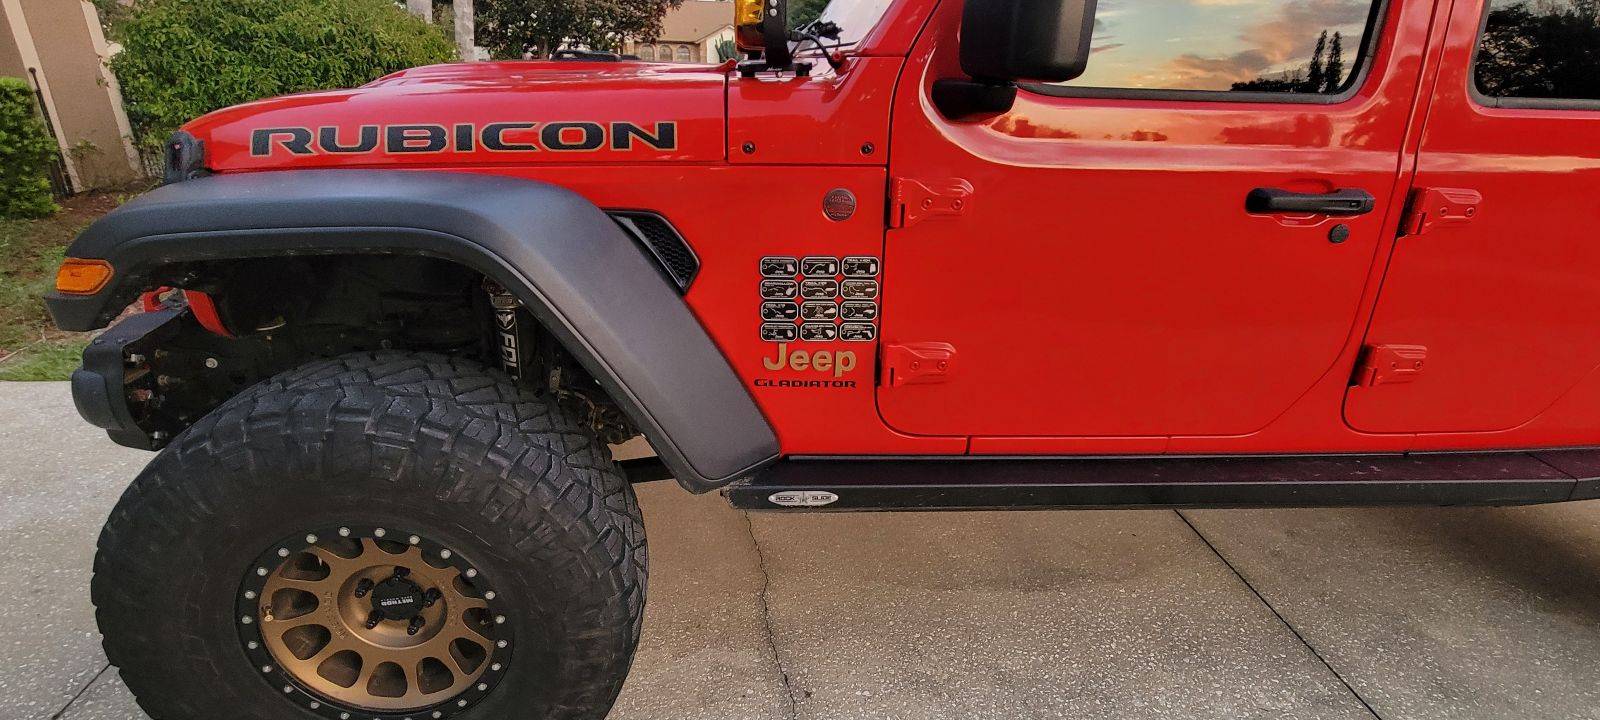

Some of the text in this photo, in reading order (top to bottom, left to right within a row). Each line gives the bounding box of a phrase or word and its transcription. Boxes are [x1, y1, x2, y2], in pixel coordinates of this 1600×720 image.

[250, 121, 679, 157] RUBICON
[763, 343, 857, 377] Jeep
[754, 379, 856, 388] GLADIATOR
